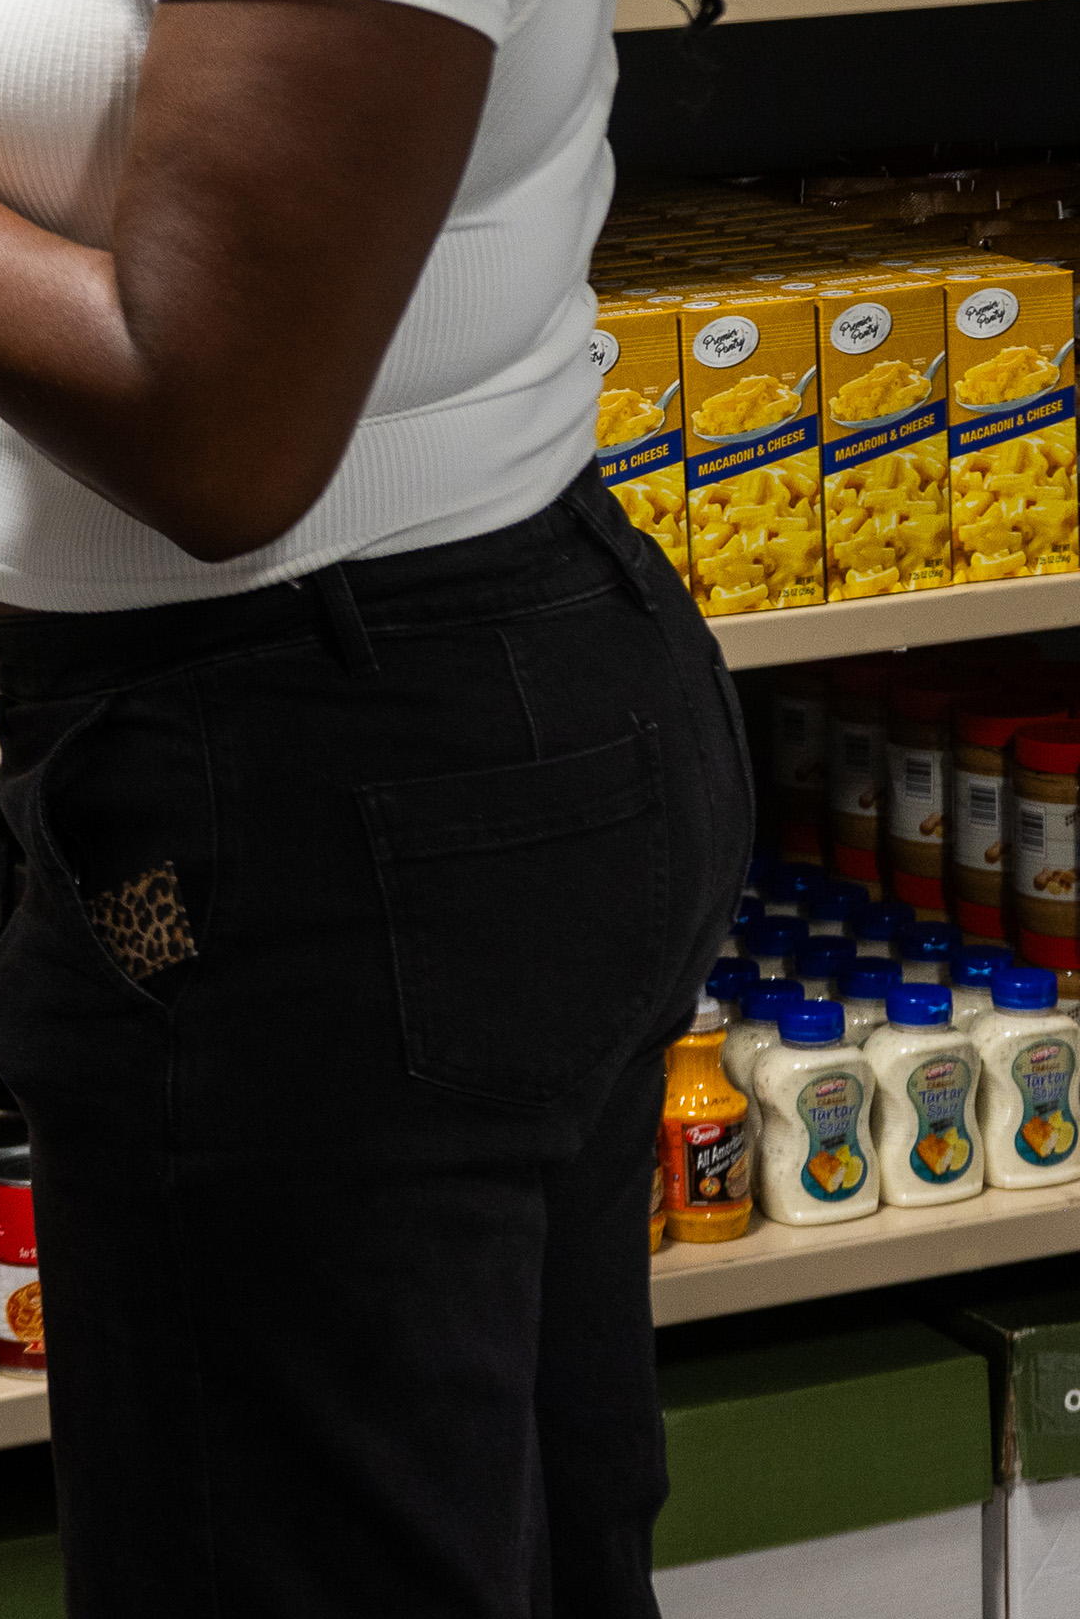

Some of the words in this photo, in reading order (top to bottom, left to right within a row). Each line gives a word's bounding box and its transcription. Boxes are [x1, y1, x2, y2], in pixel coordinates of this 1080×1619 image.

[976, 309, 1006, 328] Pantry
[702, 329, 739, 347] Premier
[850, 324, 878, 343] Pantry
[960, 420, 1014, 445] MACARONI
[1017, 416, 1024, 428] &
[1027, 400, 1064, 425] CHEESE
[835, 434, 888, 462] MACARONI
[890, 429, 898, 441] &
[899, 414, 935, 439] CHEESE
[698, 448, 754, 477] MACARONI
[757, 444, 765, 457] &
[767, 429, 805, 453] CHEESE
[1024, 1071, 1068, 1088] Tartar
[919, 1087, 963, 1104] Tartar
[809, 1105, 856, 1122] Tartar
